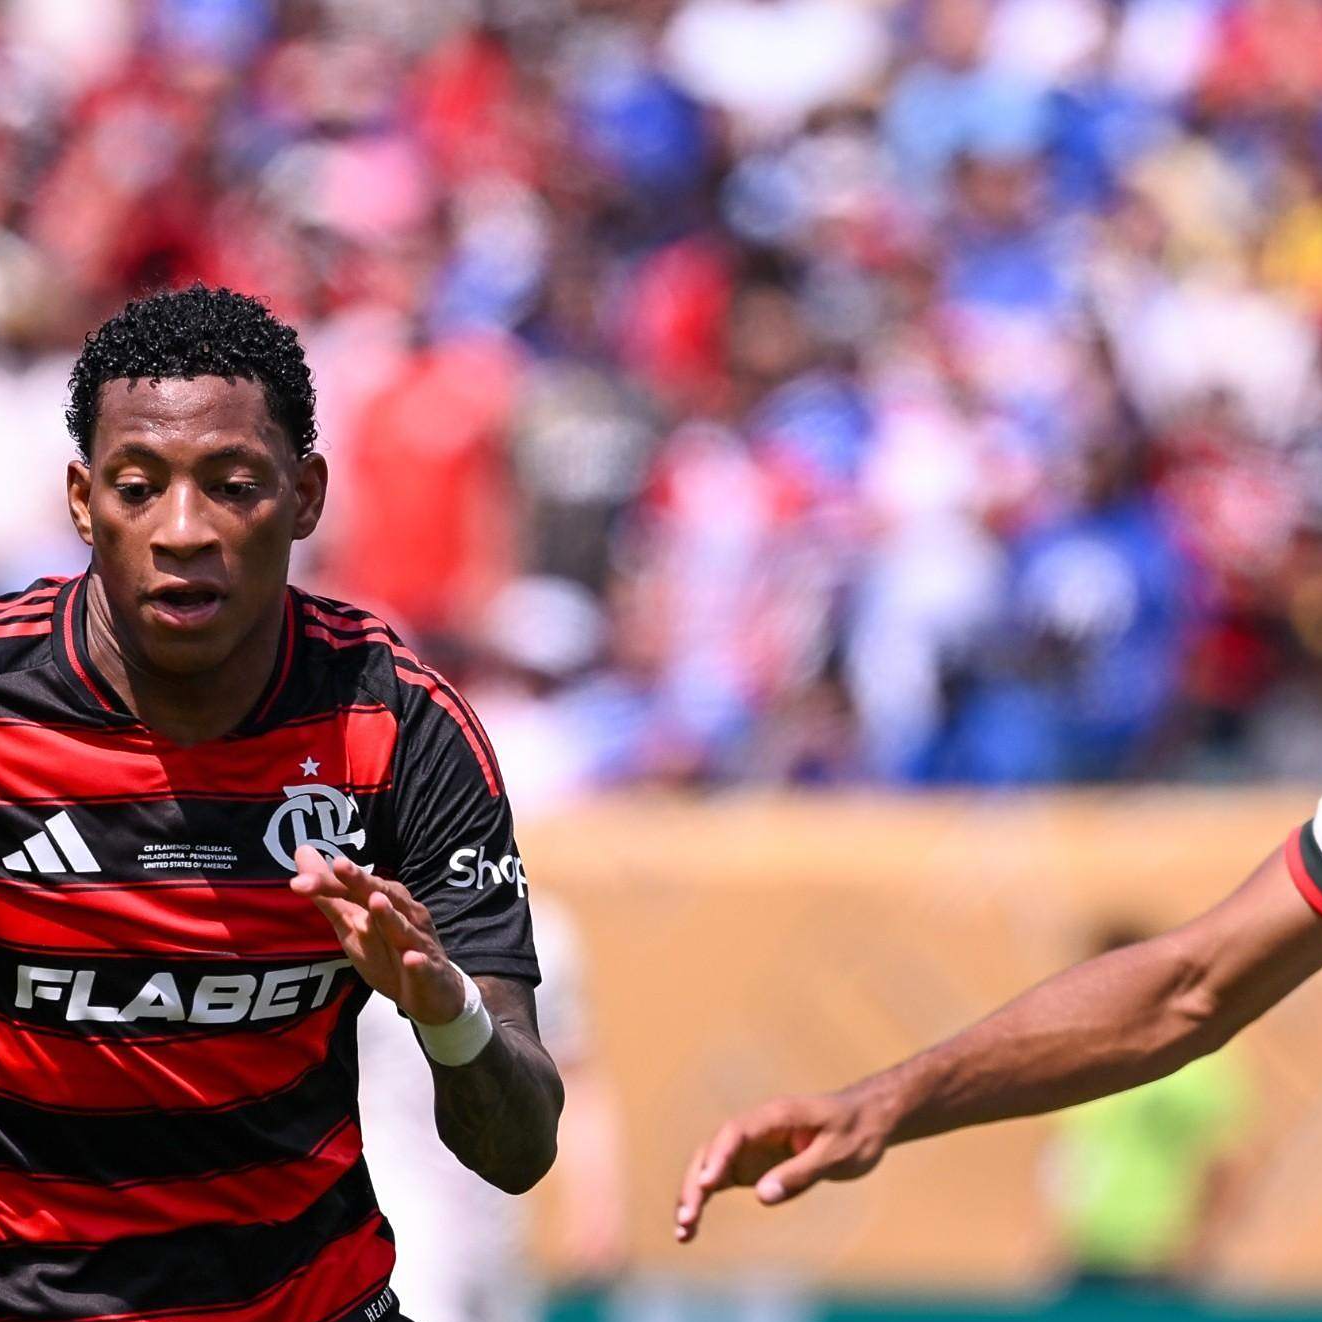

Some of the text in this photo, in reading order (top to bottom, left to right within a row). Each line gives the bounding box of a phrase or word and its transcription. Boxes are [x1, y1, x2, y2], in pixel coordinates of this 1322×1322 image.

[138, 853, 185, 861] PHILADELPHIA
[189, 853, 238, 861] PENNSYLVANIA
[203, 862, 232, 870] AMERICA
[15, 958, 358, 1024] FLABET
